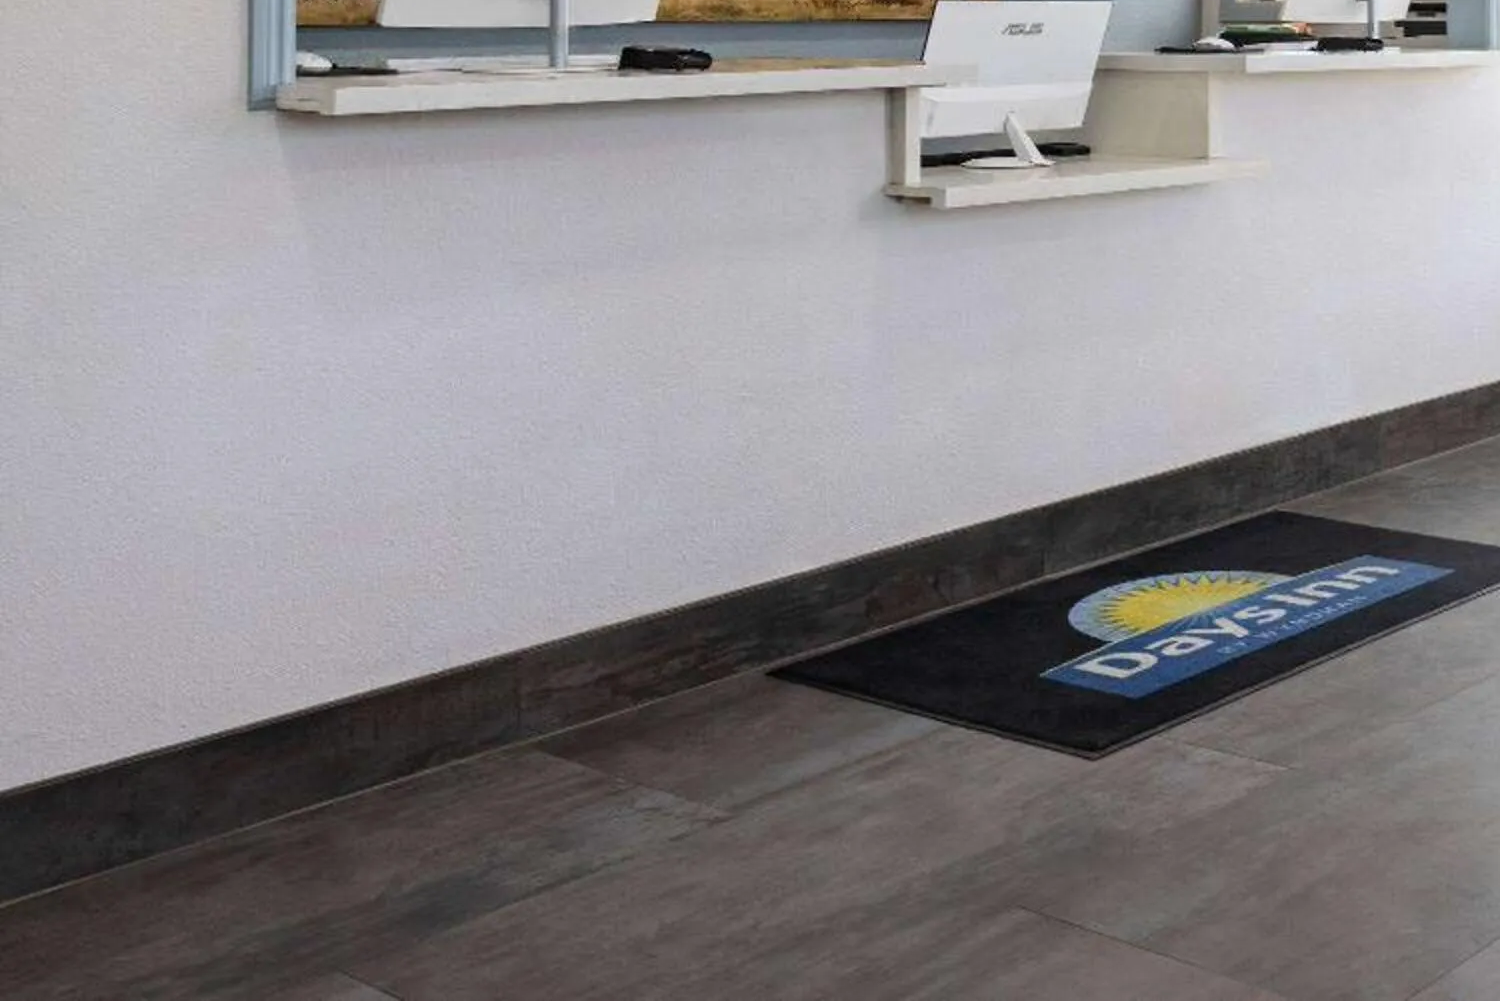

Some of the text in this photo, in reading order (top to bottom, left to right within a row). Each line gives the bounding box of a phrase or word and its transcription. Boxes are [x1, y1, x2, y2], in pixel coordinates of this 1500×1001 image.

[1001, 22, 1045, 36] ASUS
[1073, 565, 1400, 679] Days Inn
